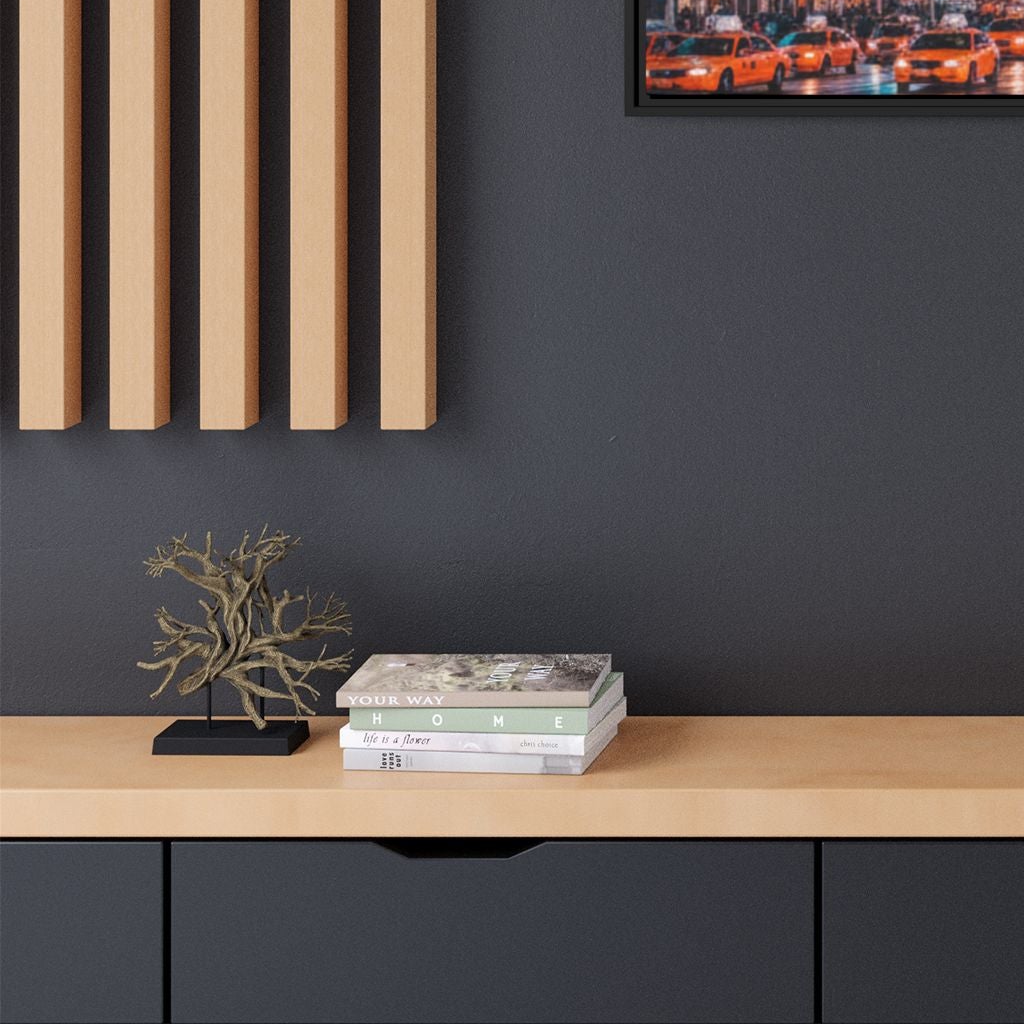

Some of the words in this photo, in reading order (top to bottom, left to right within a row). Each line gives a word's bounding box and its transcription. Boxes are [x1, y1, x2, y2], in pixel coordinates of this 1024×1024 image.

[348, 695, 400, 706] YOUR
[406, 695, 446, 706] WAY
[363, 732, 379, 747] life
[381, 734, 390, 744] is
[392, 736, 399, 744] a
[400, 733, 432, 748] flower
[380, 752, 388, 769] love
